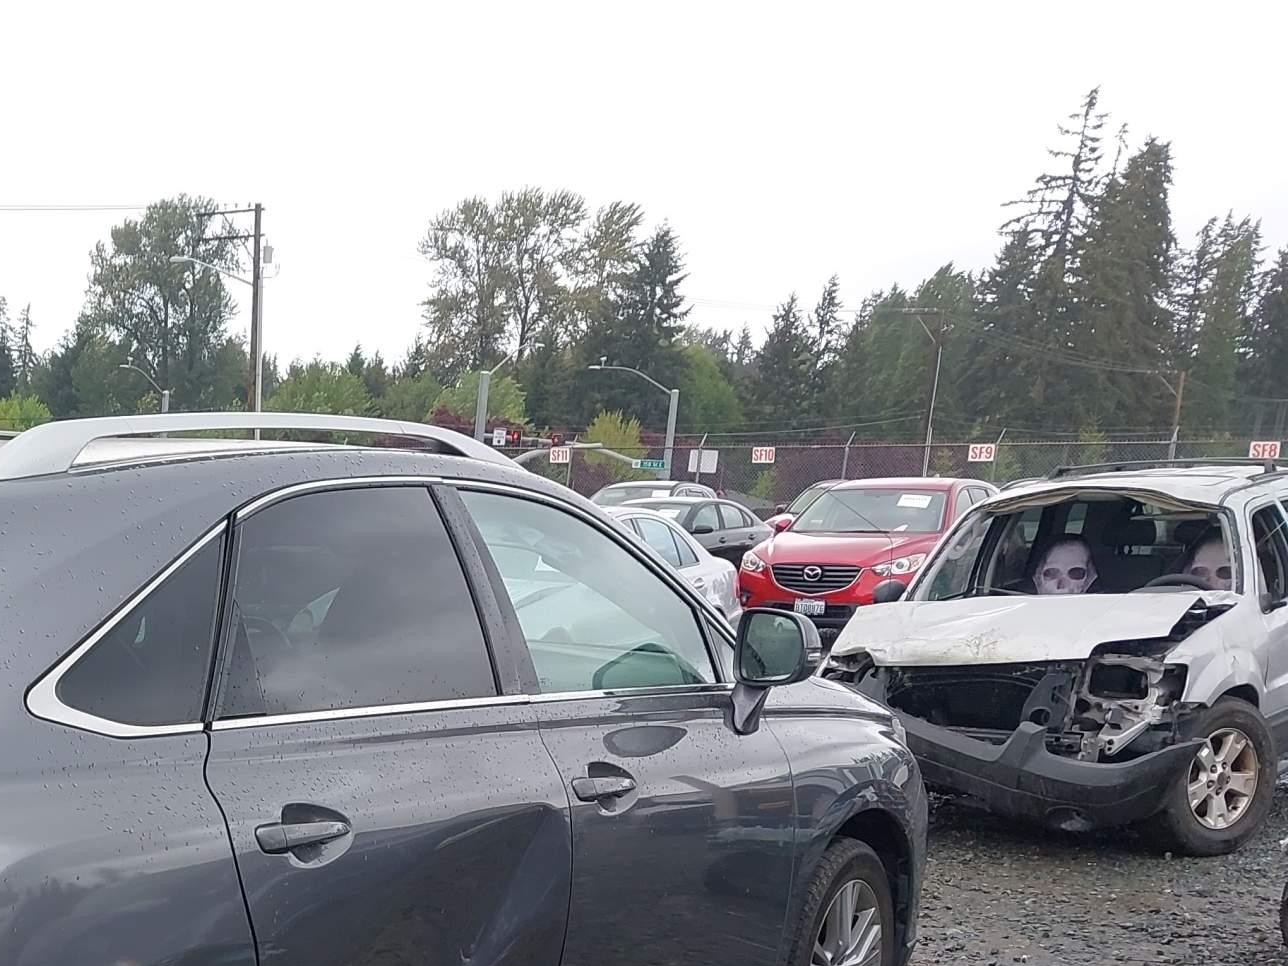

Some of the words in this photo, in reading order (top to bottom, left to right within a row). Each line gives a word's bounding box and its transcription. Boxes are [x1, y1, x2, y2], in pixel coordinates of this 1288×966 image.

[551, 449, 568, 462] SF11
[753, 448, 774, 462] SF10
[970, 446, 993, 460] SF9
[1252, 443, 1278, 458] SF8
